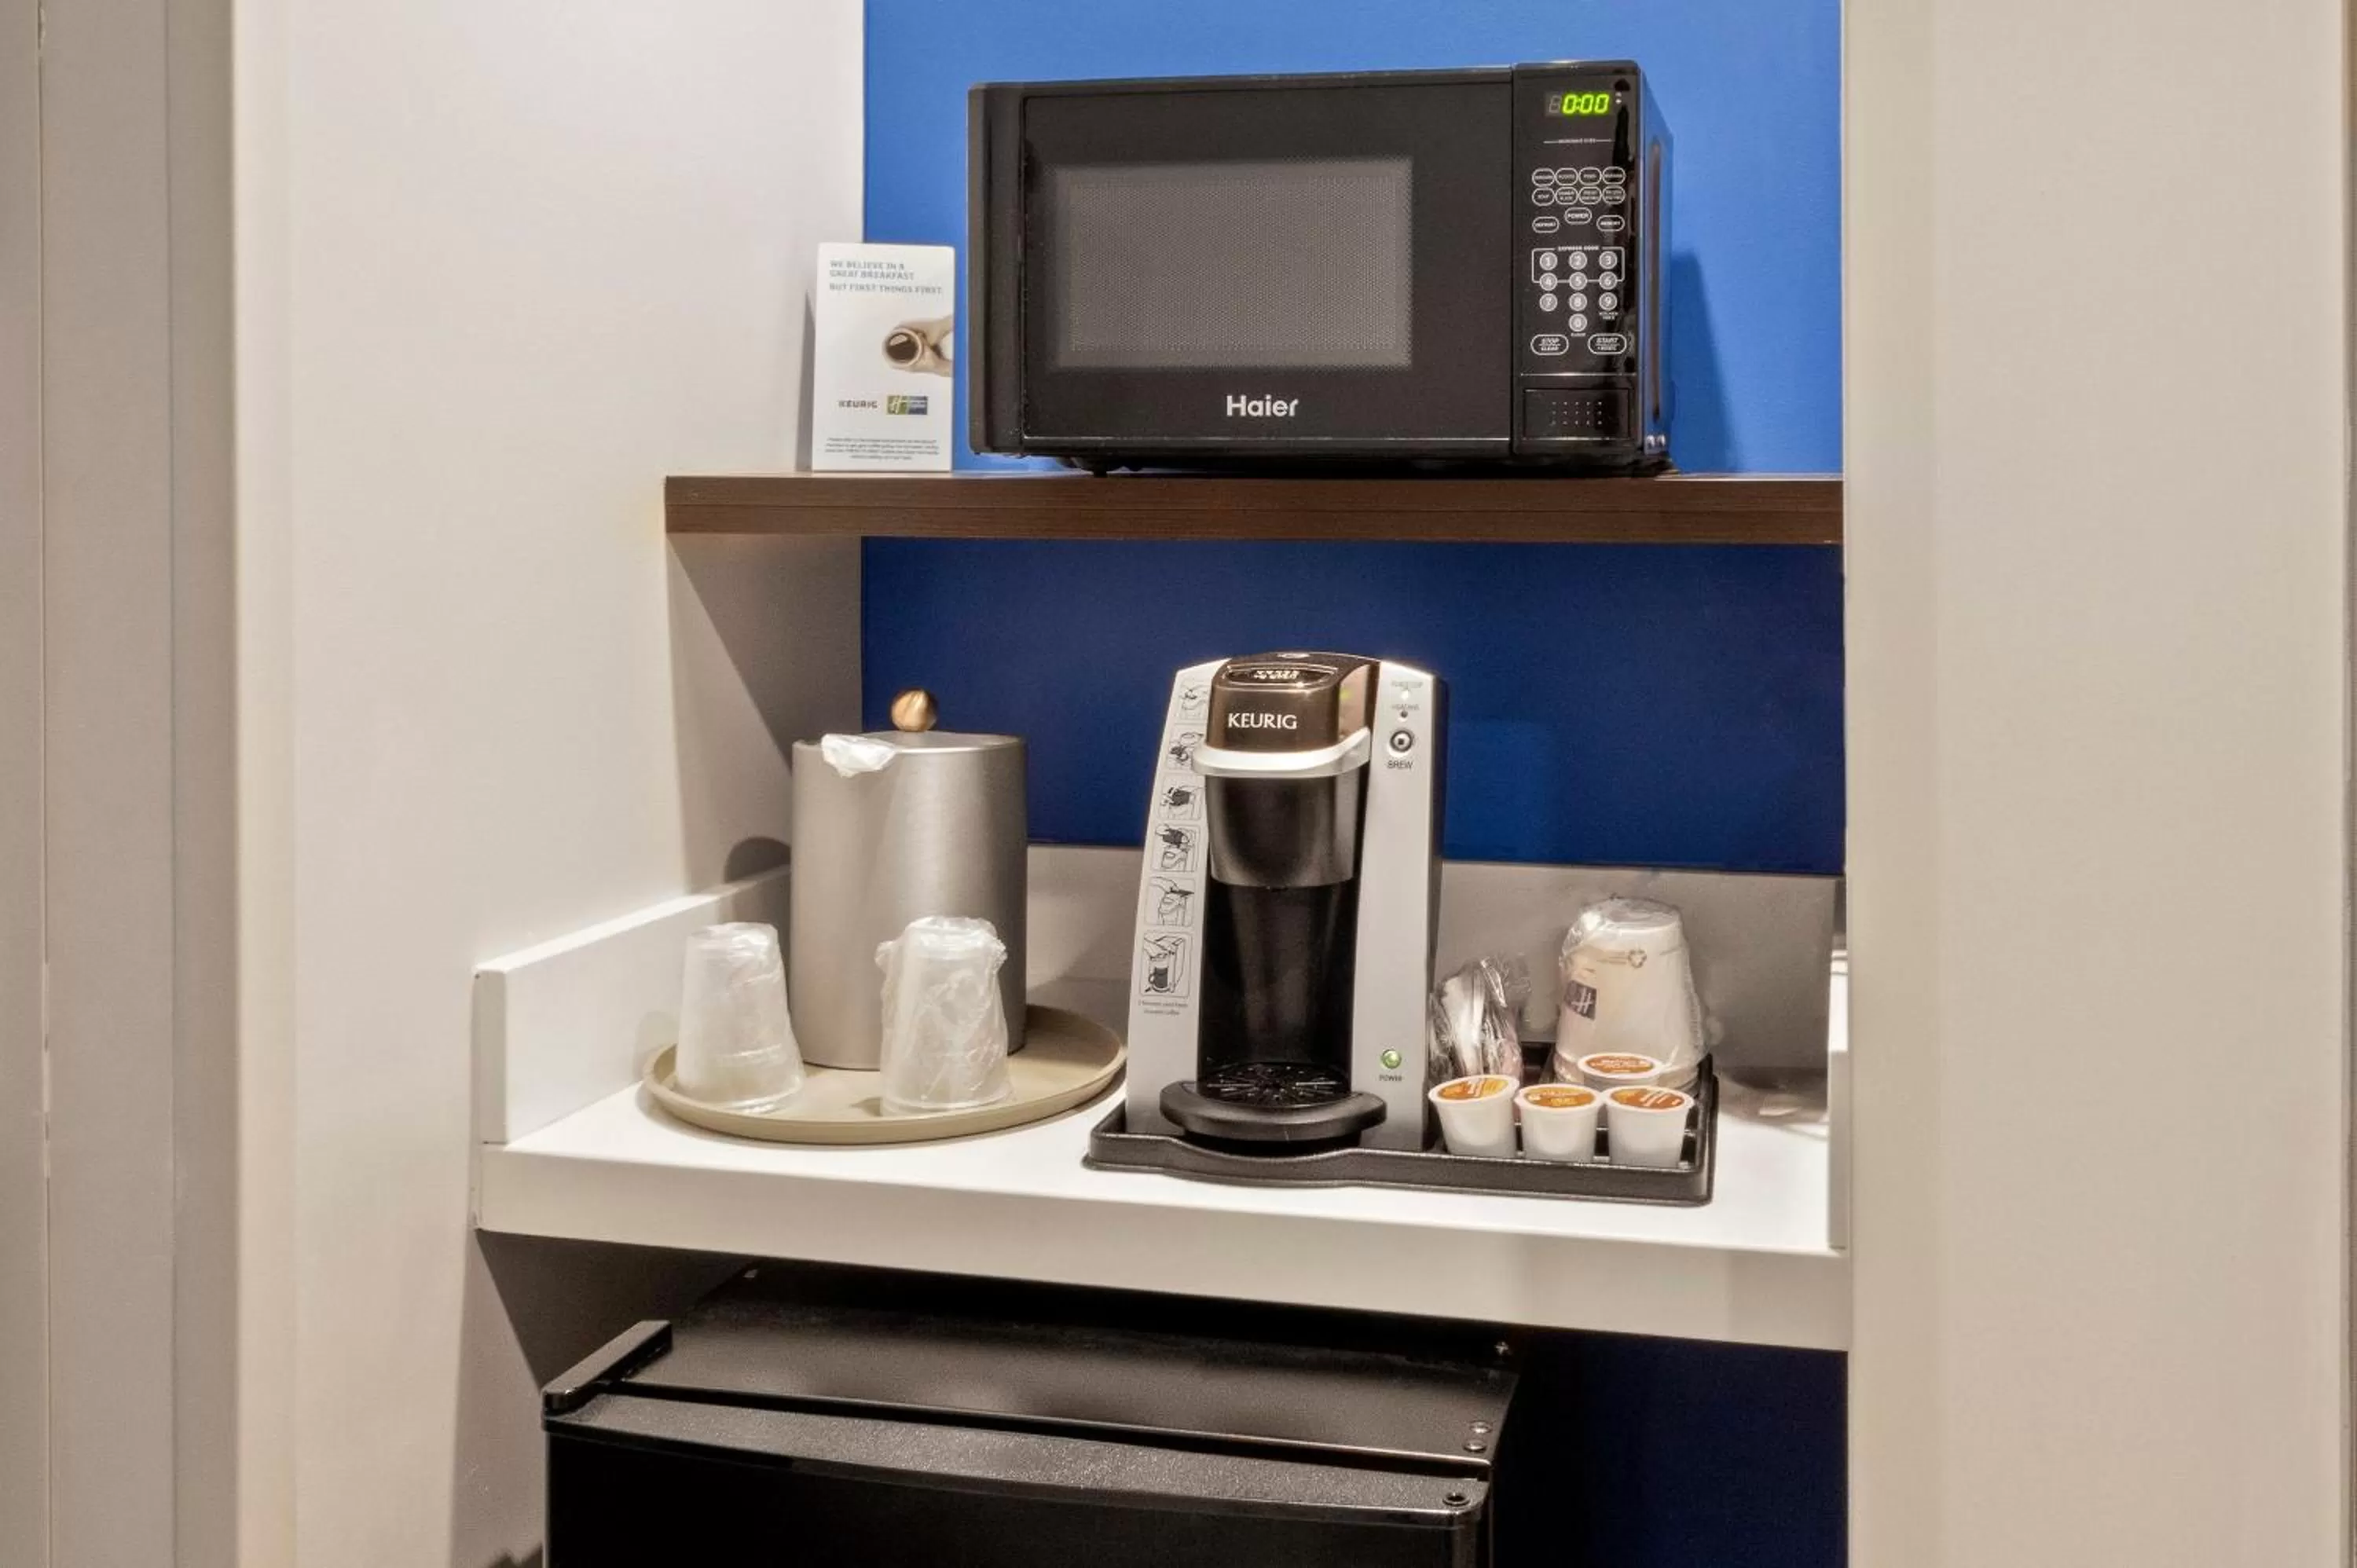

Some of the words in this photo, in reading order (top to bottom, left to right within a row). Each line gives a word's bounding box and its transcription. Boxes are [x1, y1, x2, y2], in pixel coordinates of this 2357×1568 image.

[1562, 93, 1611, 115] 0:00
[1226, 394, 1299, 417] Haier
[1227, 713, 1297, 730] KEURIG
[1387, 760, 1413, 770] BREW
